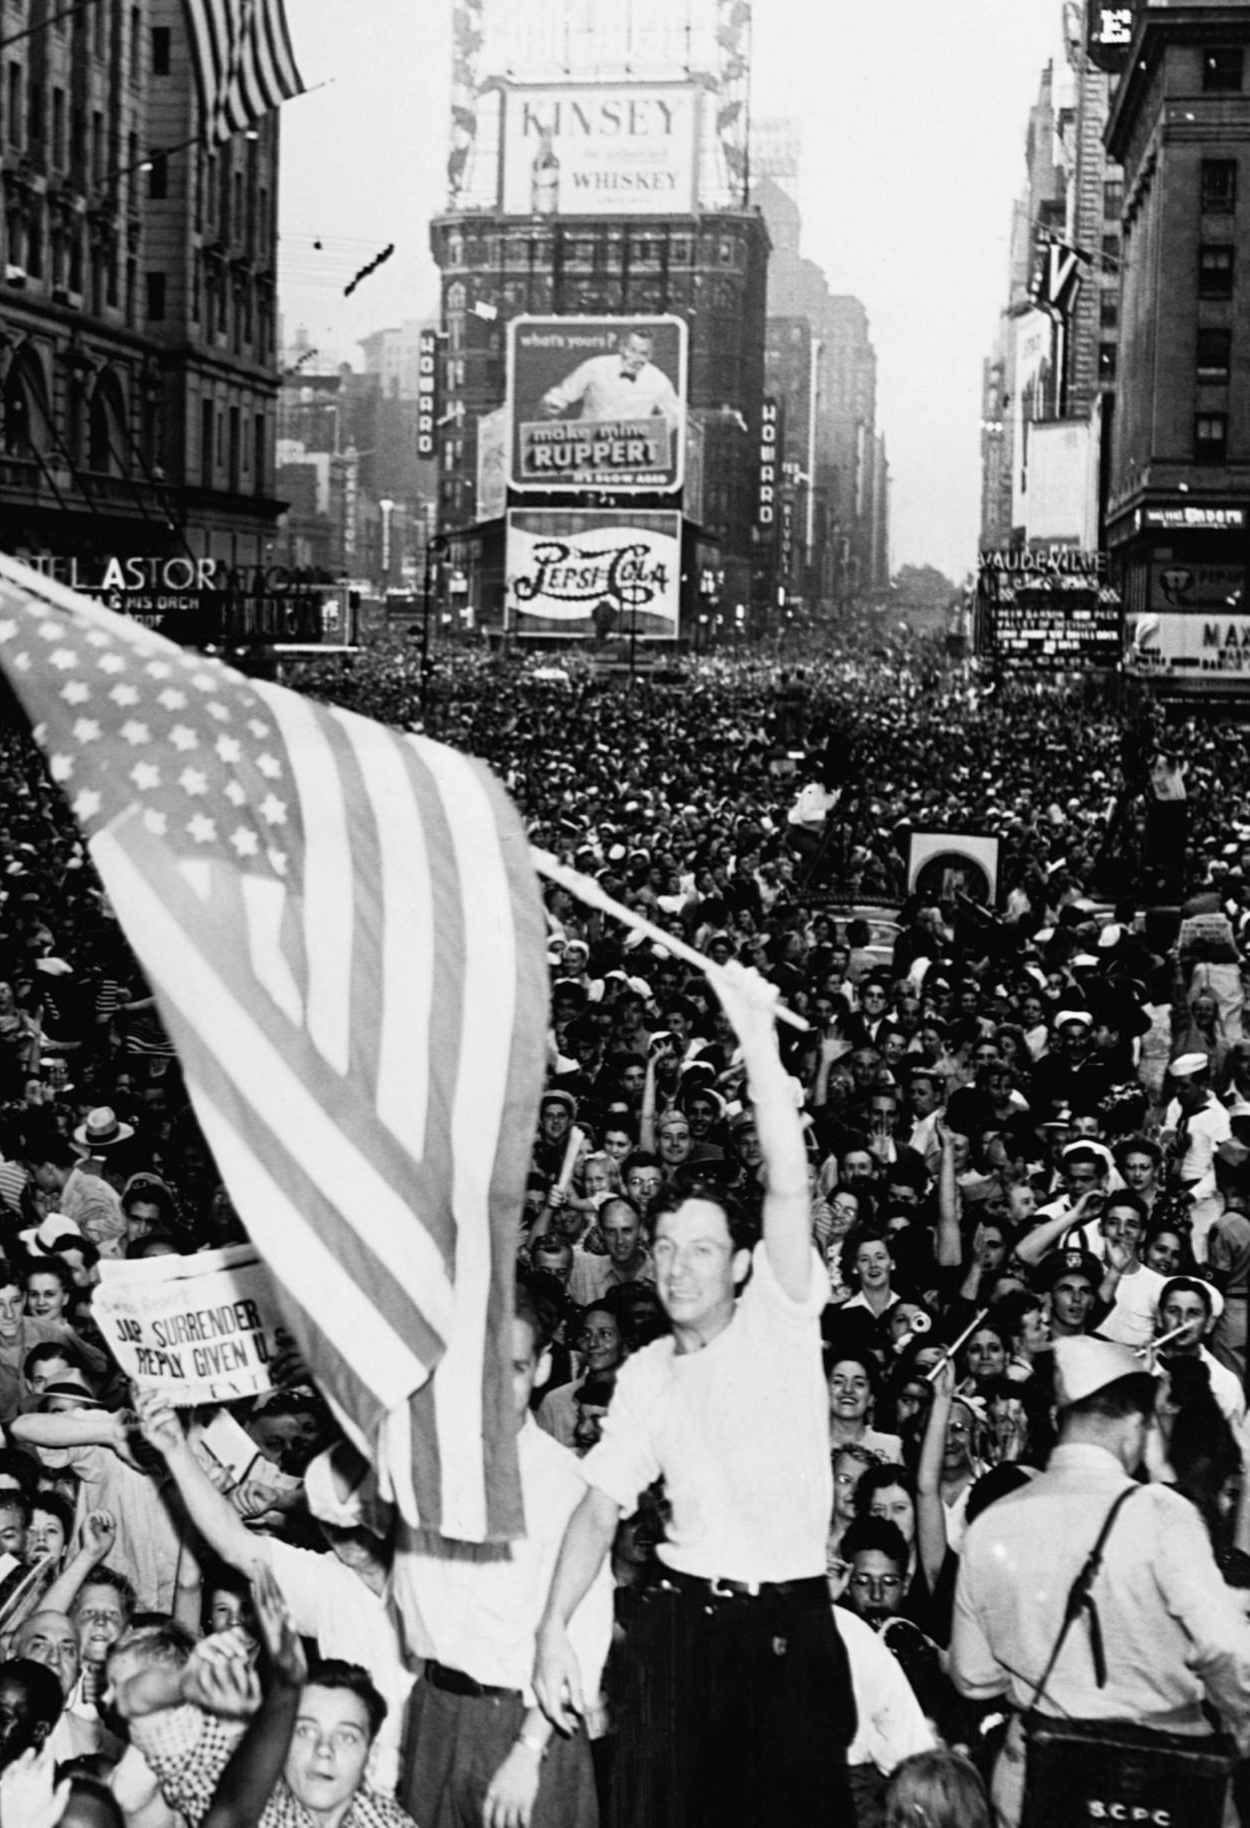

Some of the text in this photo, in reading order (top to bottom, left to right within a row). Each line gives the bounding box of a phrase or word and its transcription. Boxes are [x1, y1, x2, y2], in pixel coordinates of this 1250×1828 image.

[522, 100, 682, 137] KINSEY
[572, 172, 680, 190] WHISKEY
[419, 335, 435, 453] HOWARD
[533, 422, 650, 441] make mine
[534, 440, 660, 467] RUPPERT
[759, 406, 777, 523] HOWARD
[101, 557, 216, 590] ASTOR
[156, 596, 200, 610] ORCH
[116, 1319, 143, 1345] JAP
[152, 1299, 263, 1348] SURRENDER
[135, 1347, 185, 1379] REPLY
[192, 1340, 249, 1378] GIVEN
